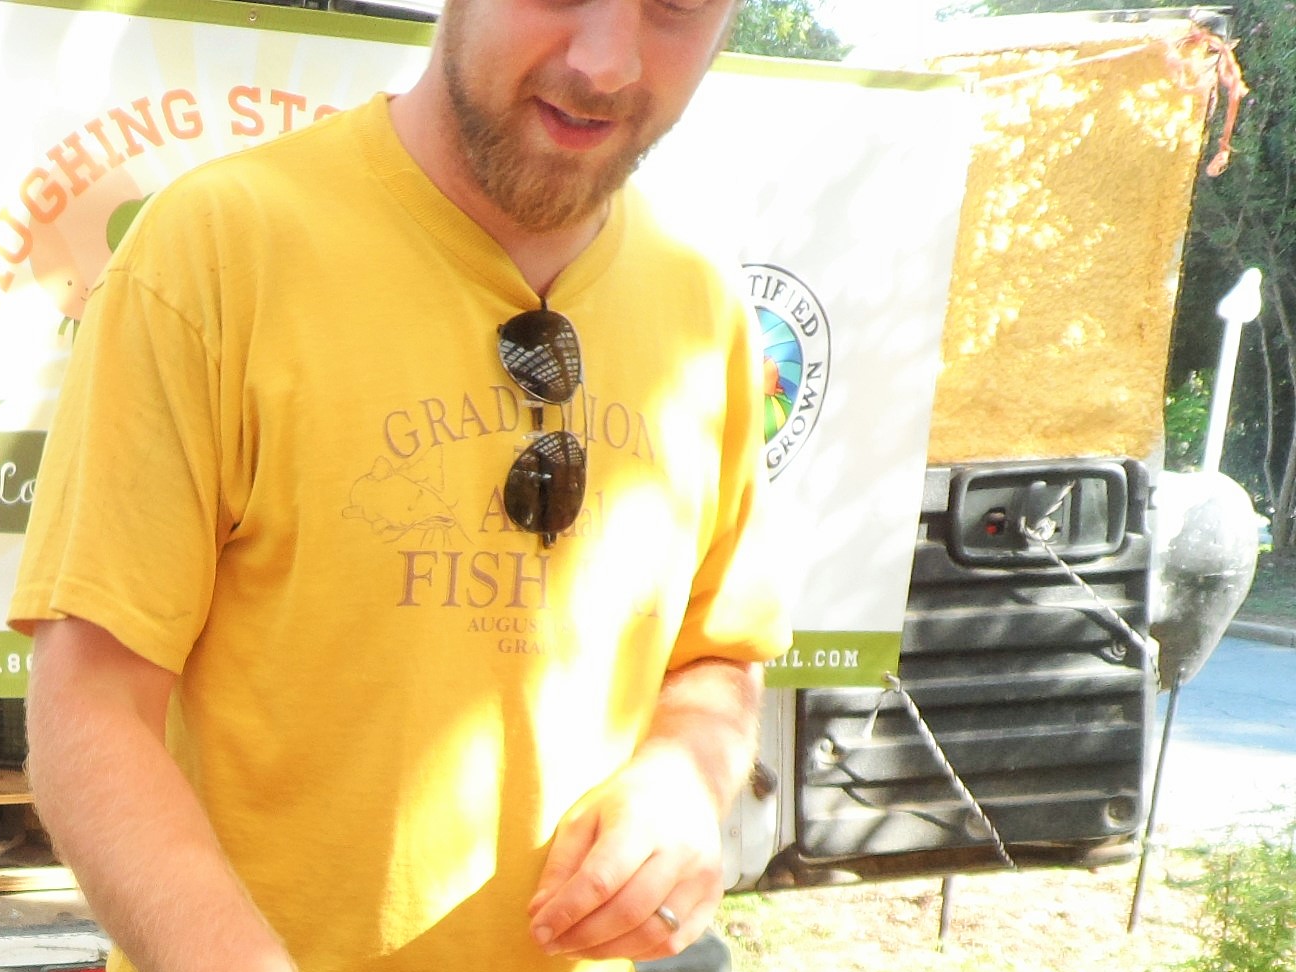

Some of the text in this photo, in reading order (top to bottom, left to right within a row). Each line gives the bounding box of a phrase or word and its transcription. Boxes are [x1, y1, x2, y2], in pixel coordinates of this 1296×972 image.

[227, 85, 344, 136] ST
[383, 385, 521, 460] GRAD
[765, 361, 823, 470] GROWN
[395, 550, 552, 610] FISH
[466, 616, 549, 634] AUGUS
